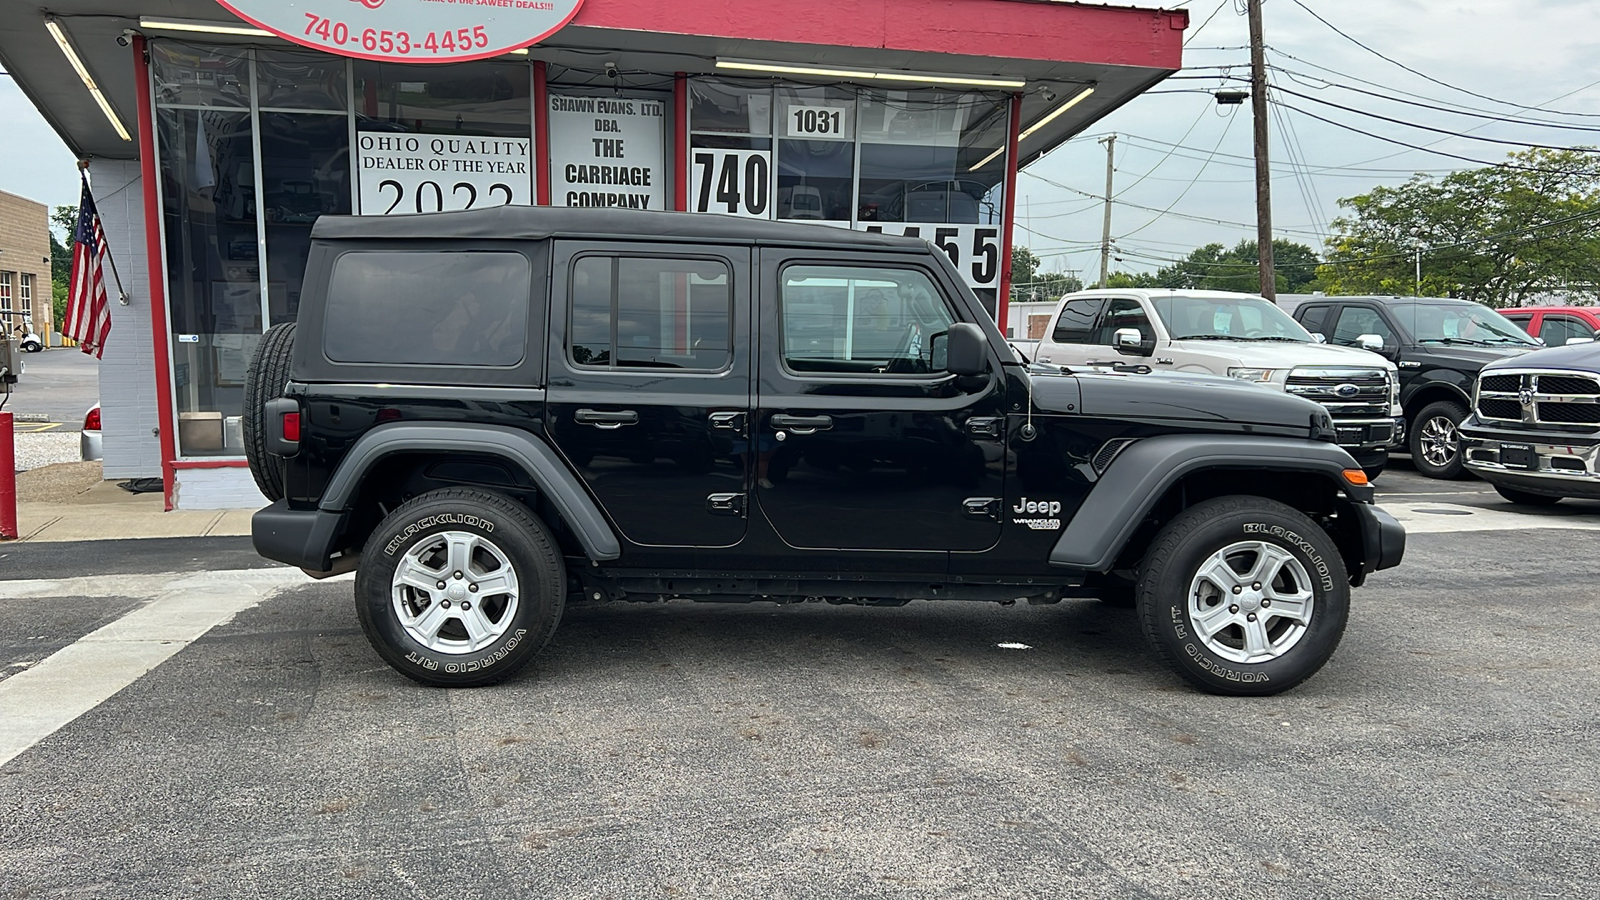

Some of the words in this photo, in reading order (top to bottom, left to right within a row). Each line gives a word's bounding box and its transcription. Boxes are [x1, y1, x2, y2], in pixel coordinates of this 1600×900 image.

[476, 0, 514, 8] SAWEET
[515, 1, 554, 10] DEALS!!!
[304, 12, 489, 54] 740-653-4455
[551, 98, 595, 113] SHAWN
[641, 103, 662, 117] LTD.
[594, 119, 621, 133] DBA.
[794, 109, 840, 134] 1031
[360, 136, 419, 152] OHIO
[430, 138, 528, 155] QUALITY
[592, 138, 624, 158] THE
[363, 156, 425, 171] DEALER
[428, 159, 449, 171] OF
[452, 160, 484, 173] THE
[487, 161, 527, 174] YEAR
[565, 164, 651, 186] CARRIAGE
[695, 153, 768, 215] 740
[566, 191, 650, 209] COMPANY
[1013, 497, 1061, 517] Jeep
[384, 513, 495, 556] BLACKLION
[1243, 523, 1334, 592] BLACKLION
[444, 628, 527, 674] VORACIO
[1184, 643, 1270, 683] VORACIO
